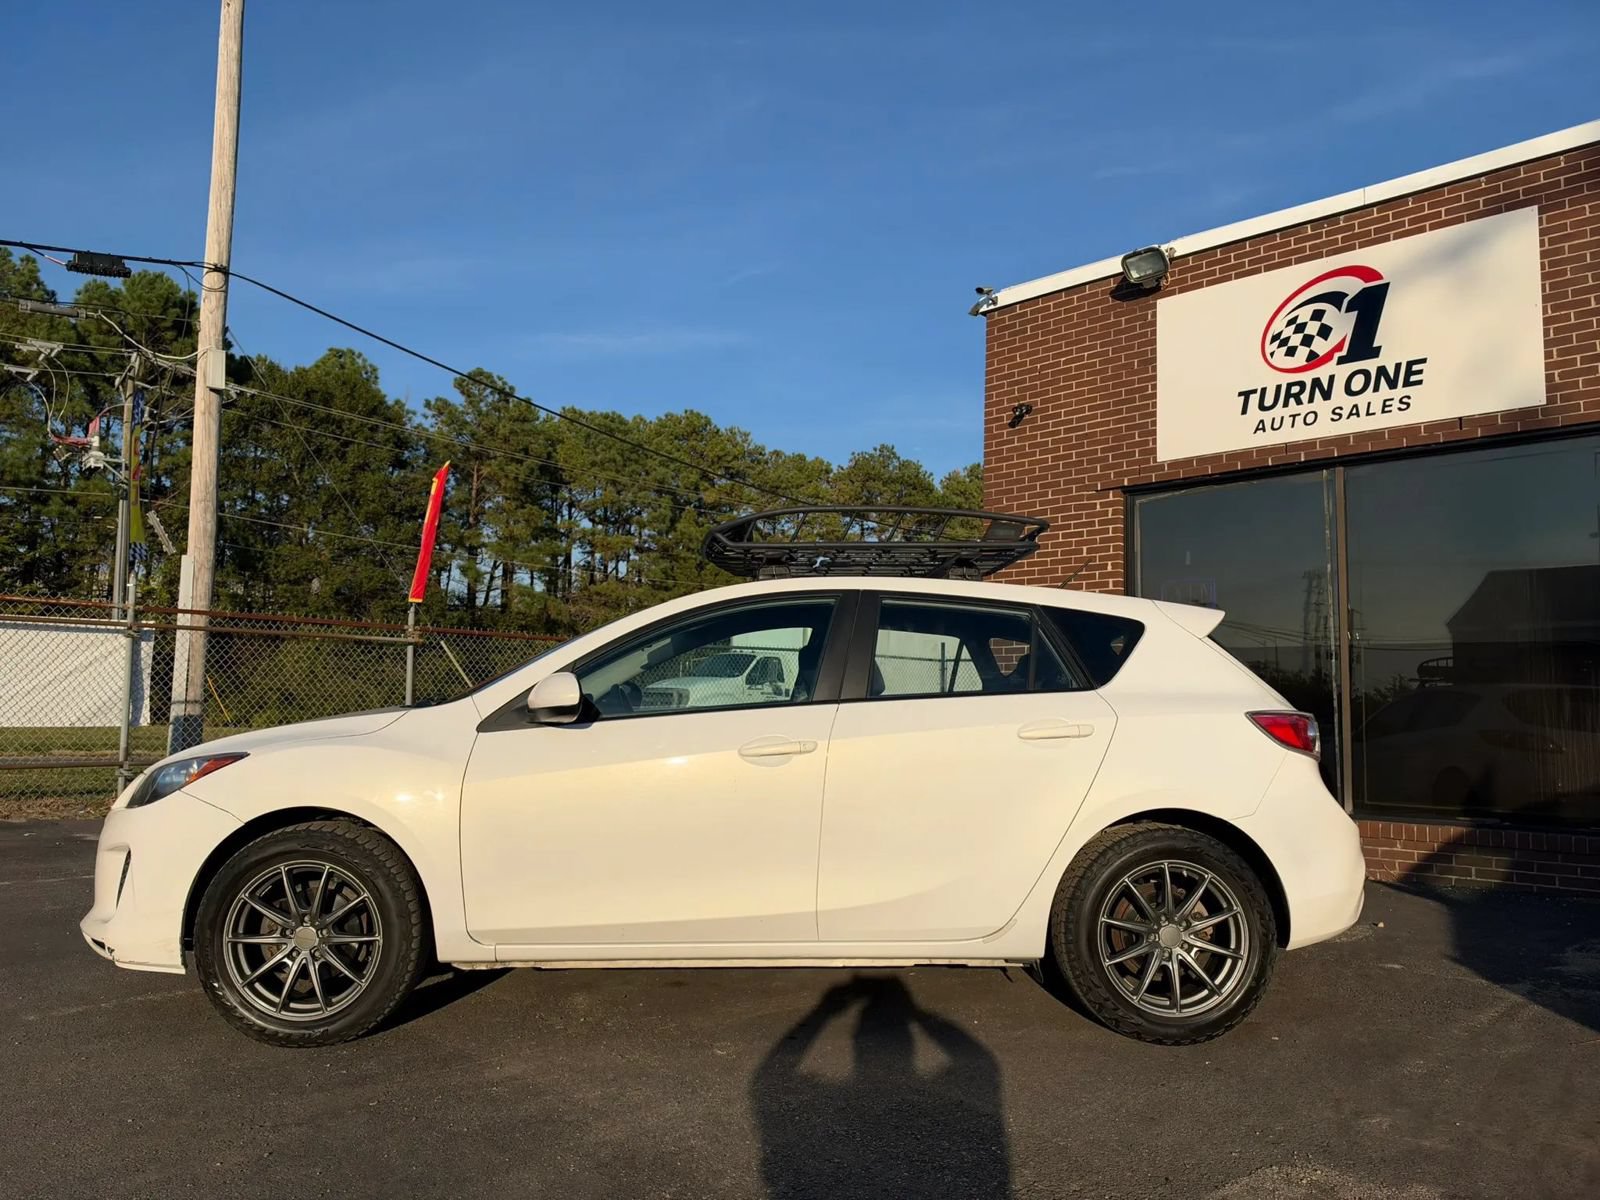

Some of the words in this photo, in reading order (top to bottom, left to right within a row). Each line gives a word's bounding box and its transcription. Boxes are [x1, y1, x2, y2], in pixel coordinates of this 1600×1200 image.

[1237, 373, 1336, 416] TURN
[1344, 357, 1428, 397] ONE
[1253, 410, 1319, 435] AUTO
[1330, 395, 1412, 422] SALES
